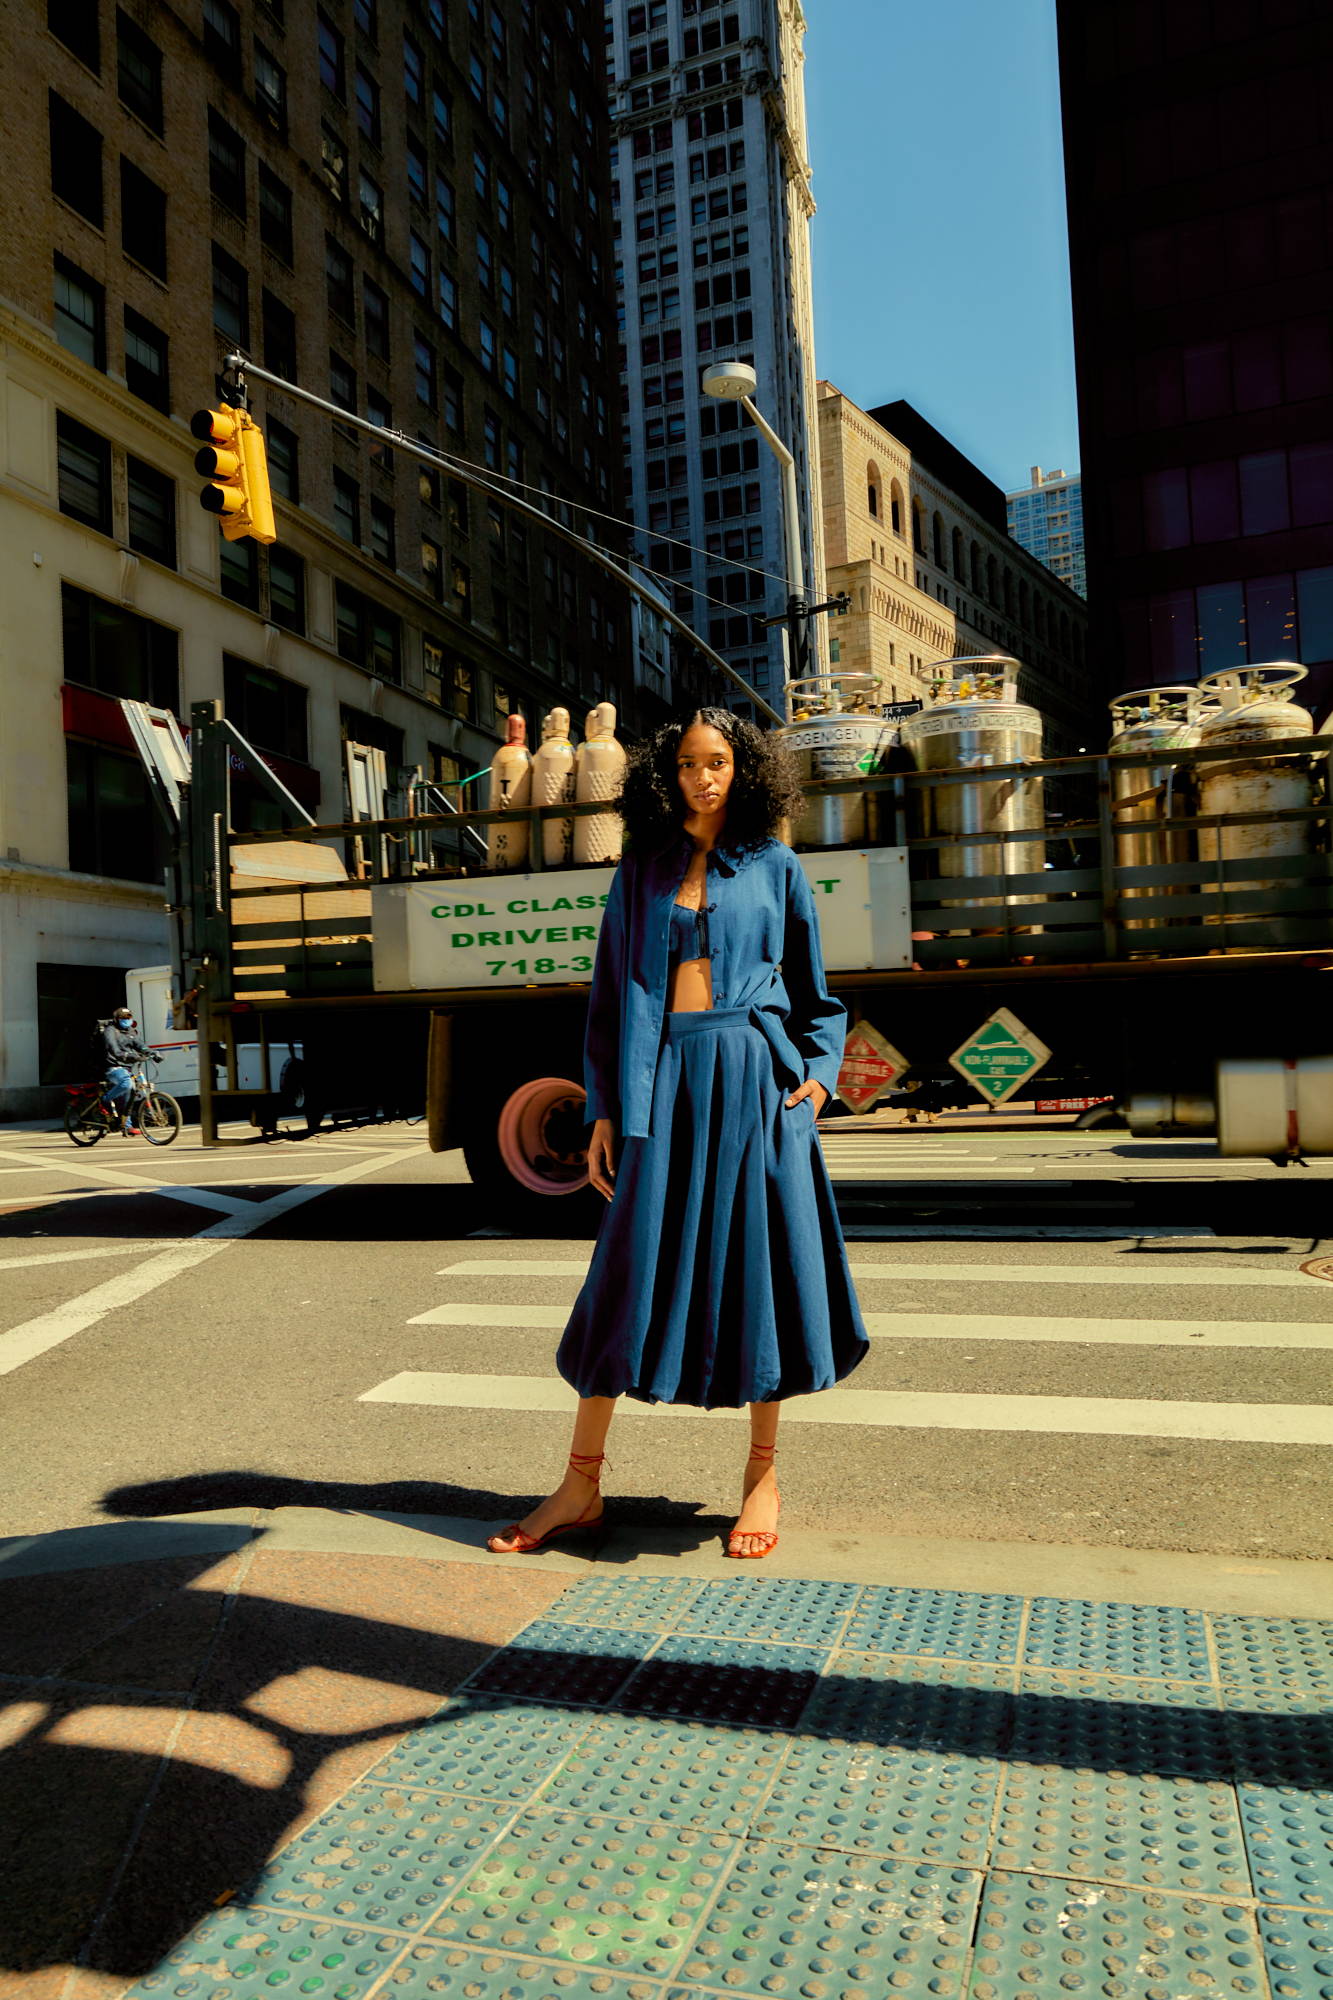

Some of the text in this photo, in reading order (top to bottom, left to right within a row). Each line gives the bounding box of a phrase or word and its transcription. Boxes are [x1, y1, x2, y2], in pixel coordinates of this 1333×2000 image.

[431, 903, 495, 919] CDL
[451, 925, 597, 948] DRIVER
[992, 1080, 1003, 1091] 2
[851, 1088, 862, 1098] 2
[1060, 1101, 1085, 1109] FREE
